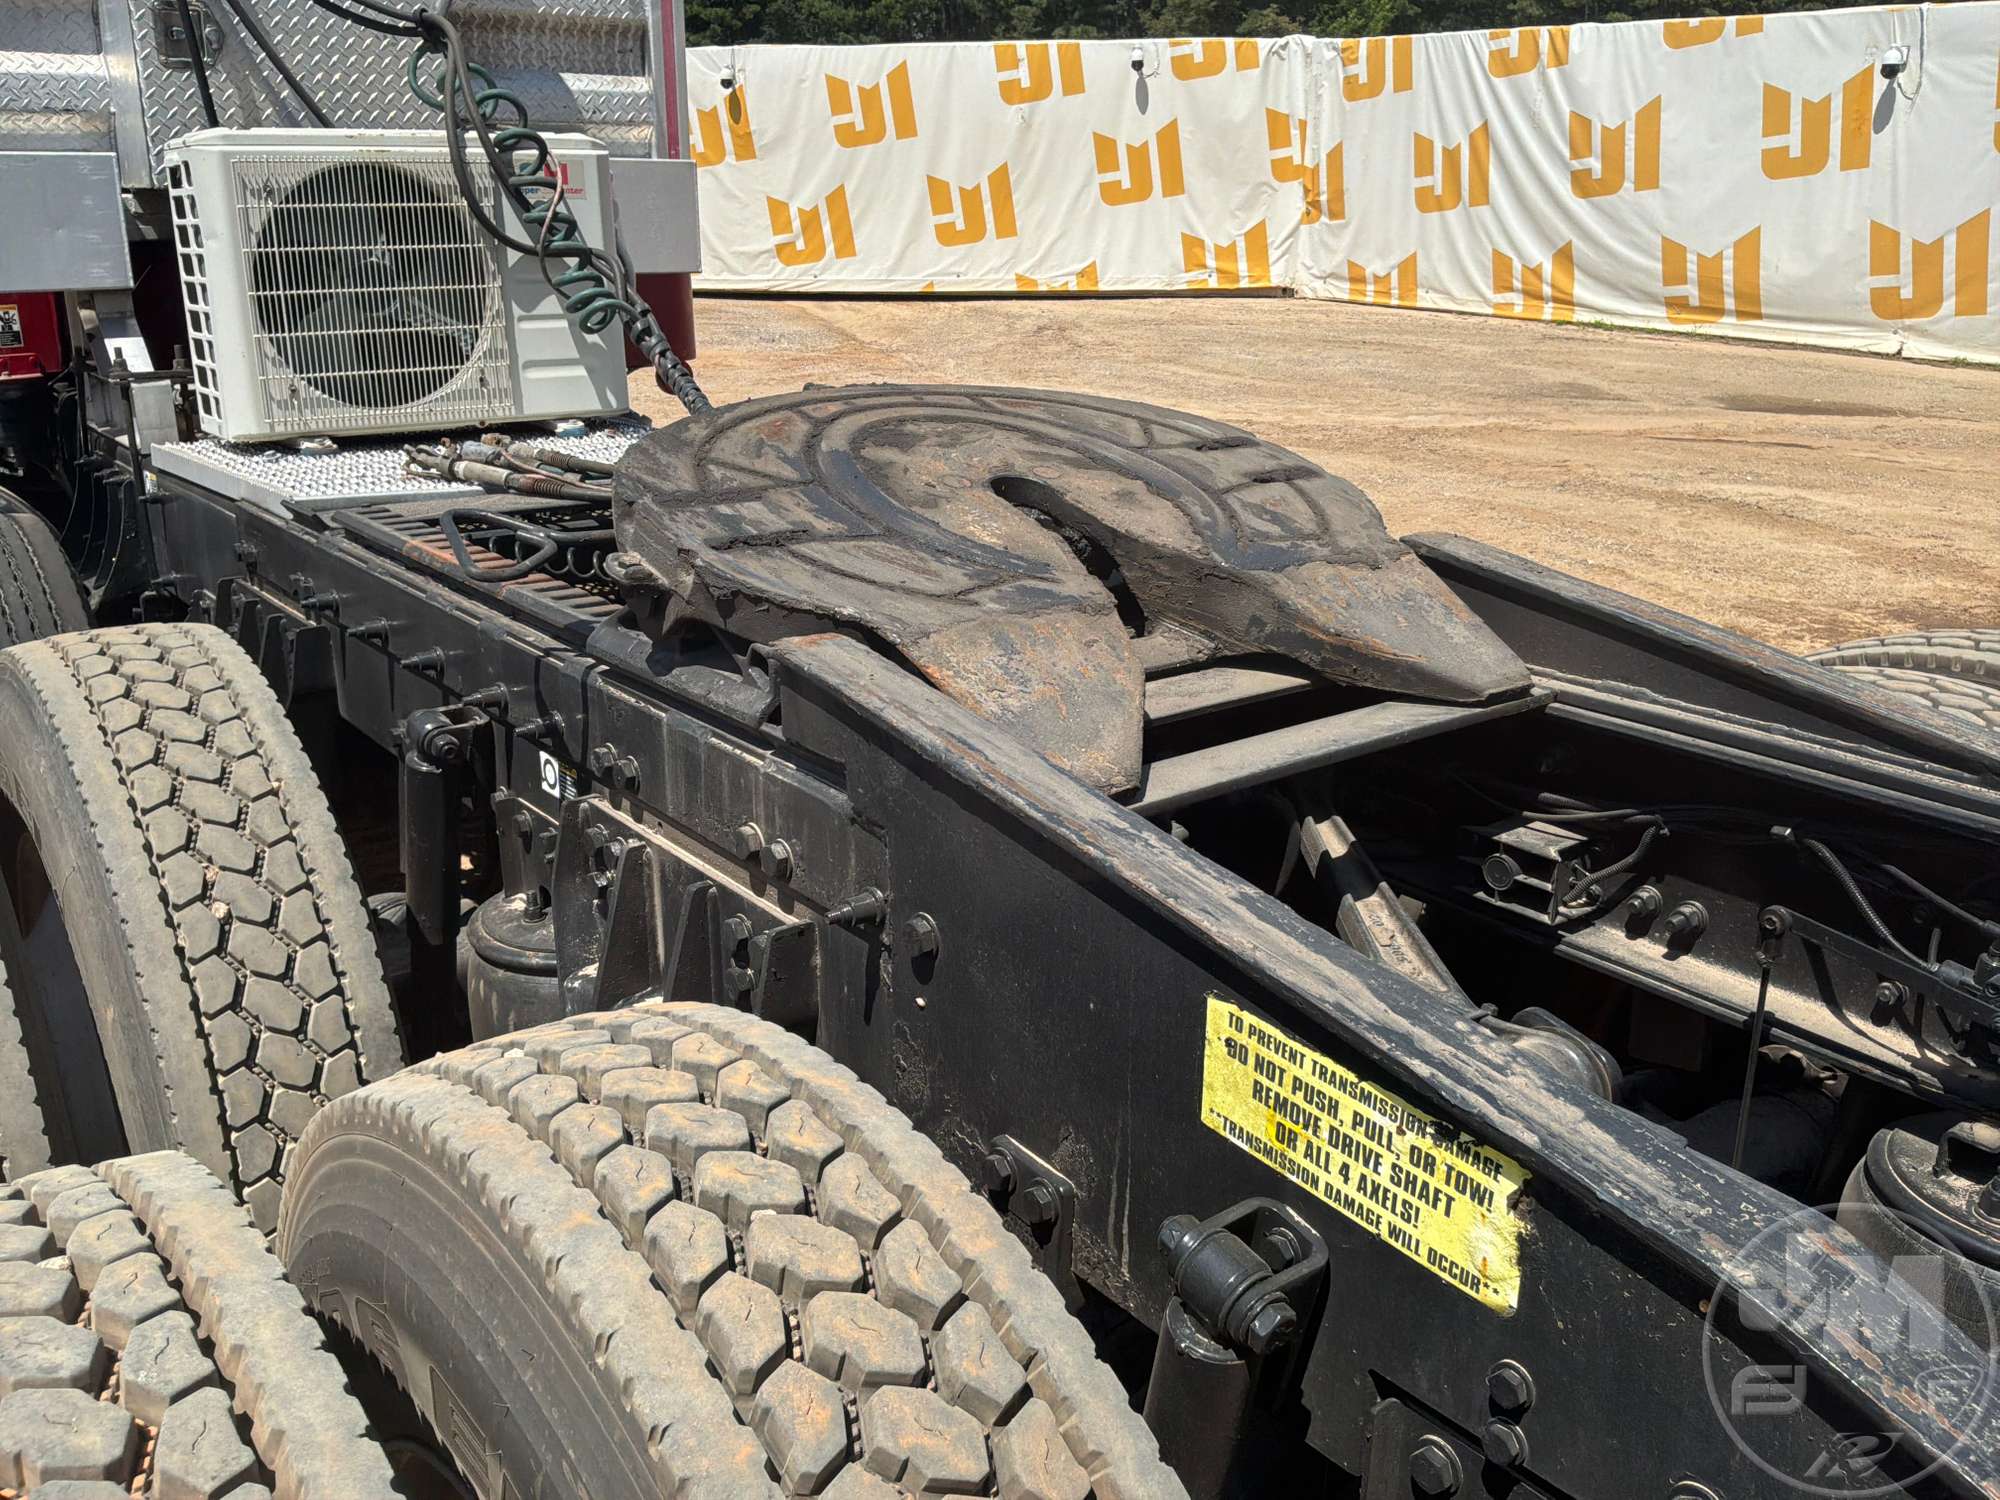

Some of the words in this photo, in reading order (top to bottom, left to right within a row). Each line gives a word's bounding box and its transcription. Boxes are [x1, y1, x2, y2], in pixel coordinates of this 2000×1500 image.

[1228, 1011, 1244, 1034] TO
[1248, 1023, 1306, 1070] PREVENT
[1311, 1059, 1429, 1139] TRANSMISSION
[1254, 1052, 1287, 1088] NOT
[1291, 1074, 1344, 1127] PUSH,
[1351, 1110, 1401, 1161] PULL,
[1409, 1144, 1437, 1178] OR
[1444, 1163, 1495, 1214] TOW!
[1252, 1078, 1322, 1140] REMOVE
[1327, 1124, 1384, 1177] DRIVE
[1389, 1161, 1456, 1219] SHAFT
[1275, 1121, 1299, 1153] OR
[1303, 1139, 1332, 1175] ALL
[1338, 1161, 1350, 1186] 4
[1357, 1172, 1421, 1229] AXELS!
[1324, 1181, 1383, 1233] DAMAGE
[1388, 1220, 1421, 1257] WILL
